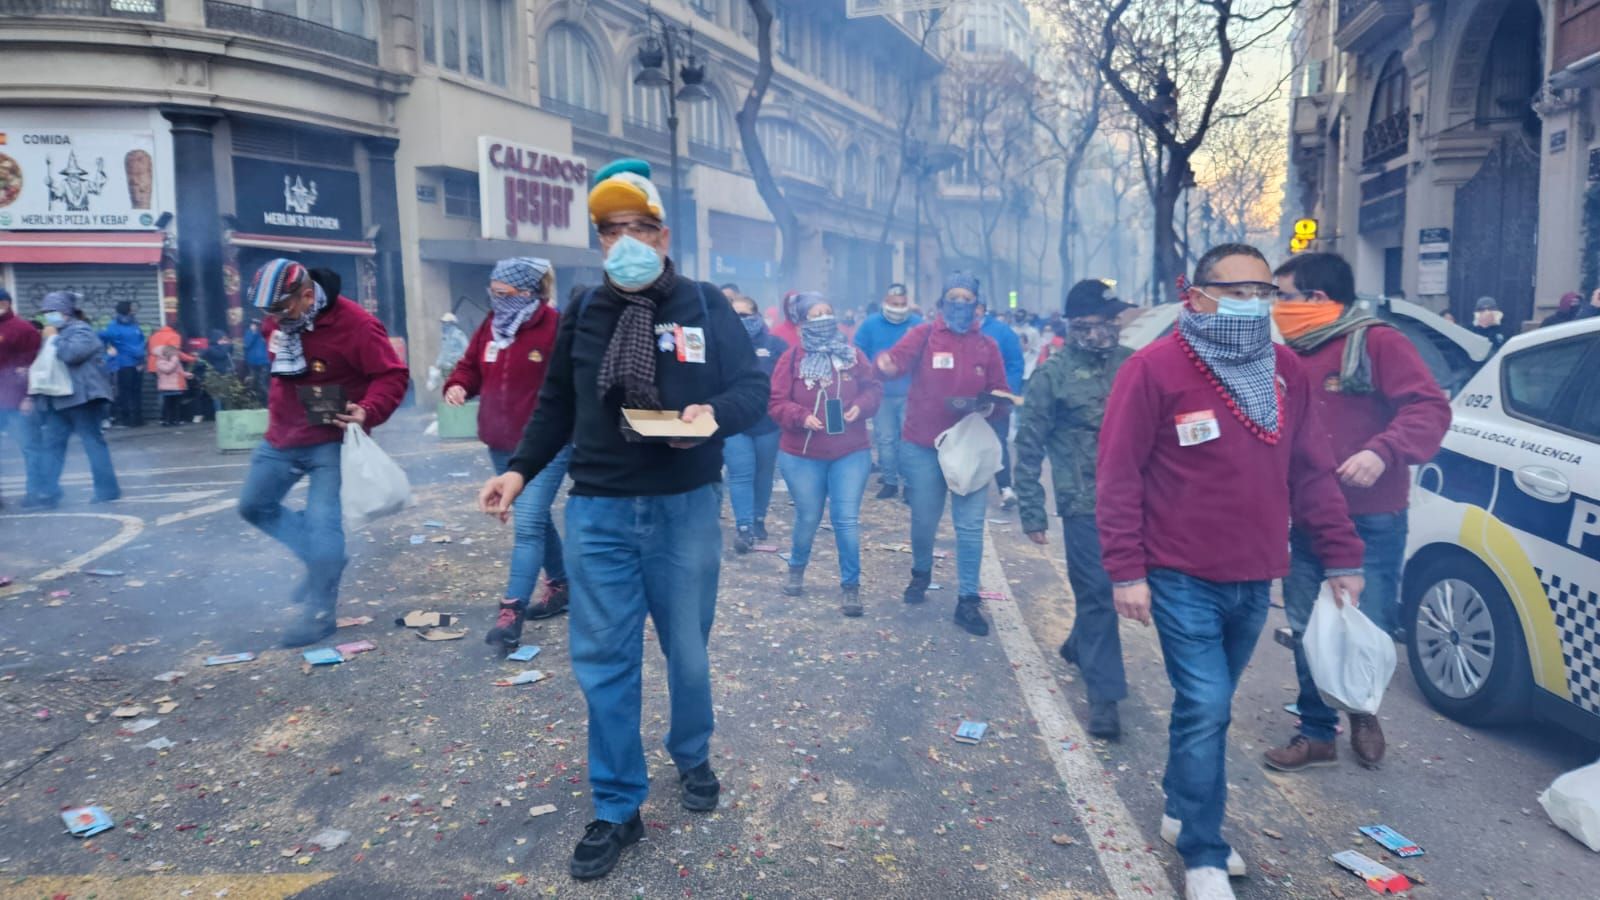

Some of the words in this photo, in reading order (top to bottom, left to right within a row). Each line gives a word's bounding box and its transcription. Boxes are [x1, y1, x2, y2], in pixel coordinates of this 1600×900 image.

[22, 134, 71, 145] COMIDA
[489, 143, 586, 185] CALZADOS
[504, 176, 574, 241] gaspar
[21, 214, 63, 225] MERLIN'S
[64, 214, 90, 225] PIZZA
[92, 214, 99, 225] Y
[100, 214, 129, 225] KEBAP
[264, 211, 304, 227] MERLIN'S
[304, 215, 340, 230] KITCHEN
[1465, 393, 1493, 409] 092
[1450, 424, 1480, 437] OLICIA
[1481, 430, 1518, 447] LOCAL
[1520, 440, 1583, 465] VALENCIA
